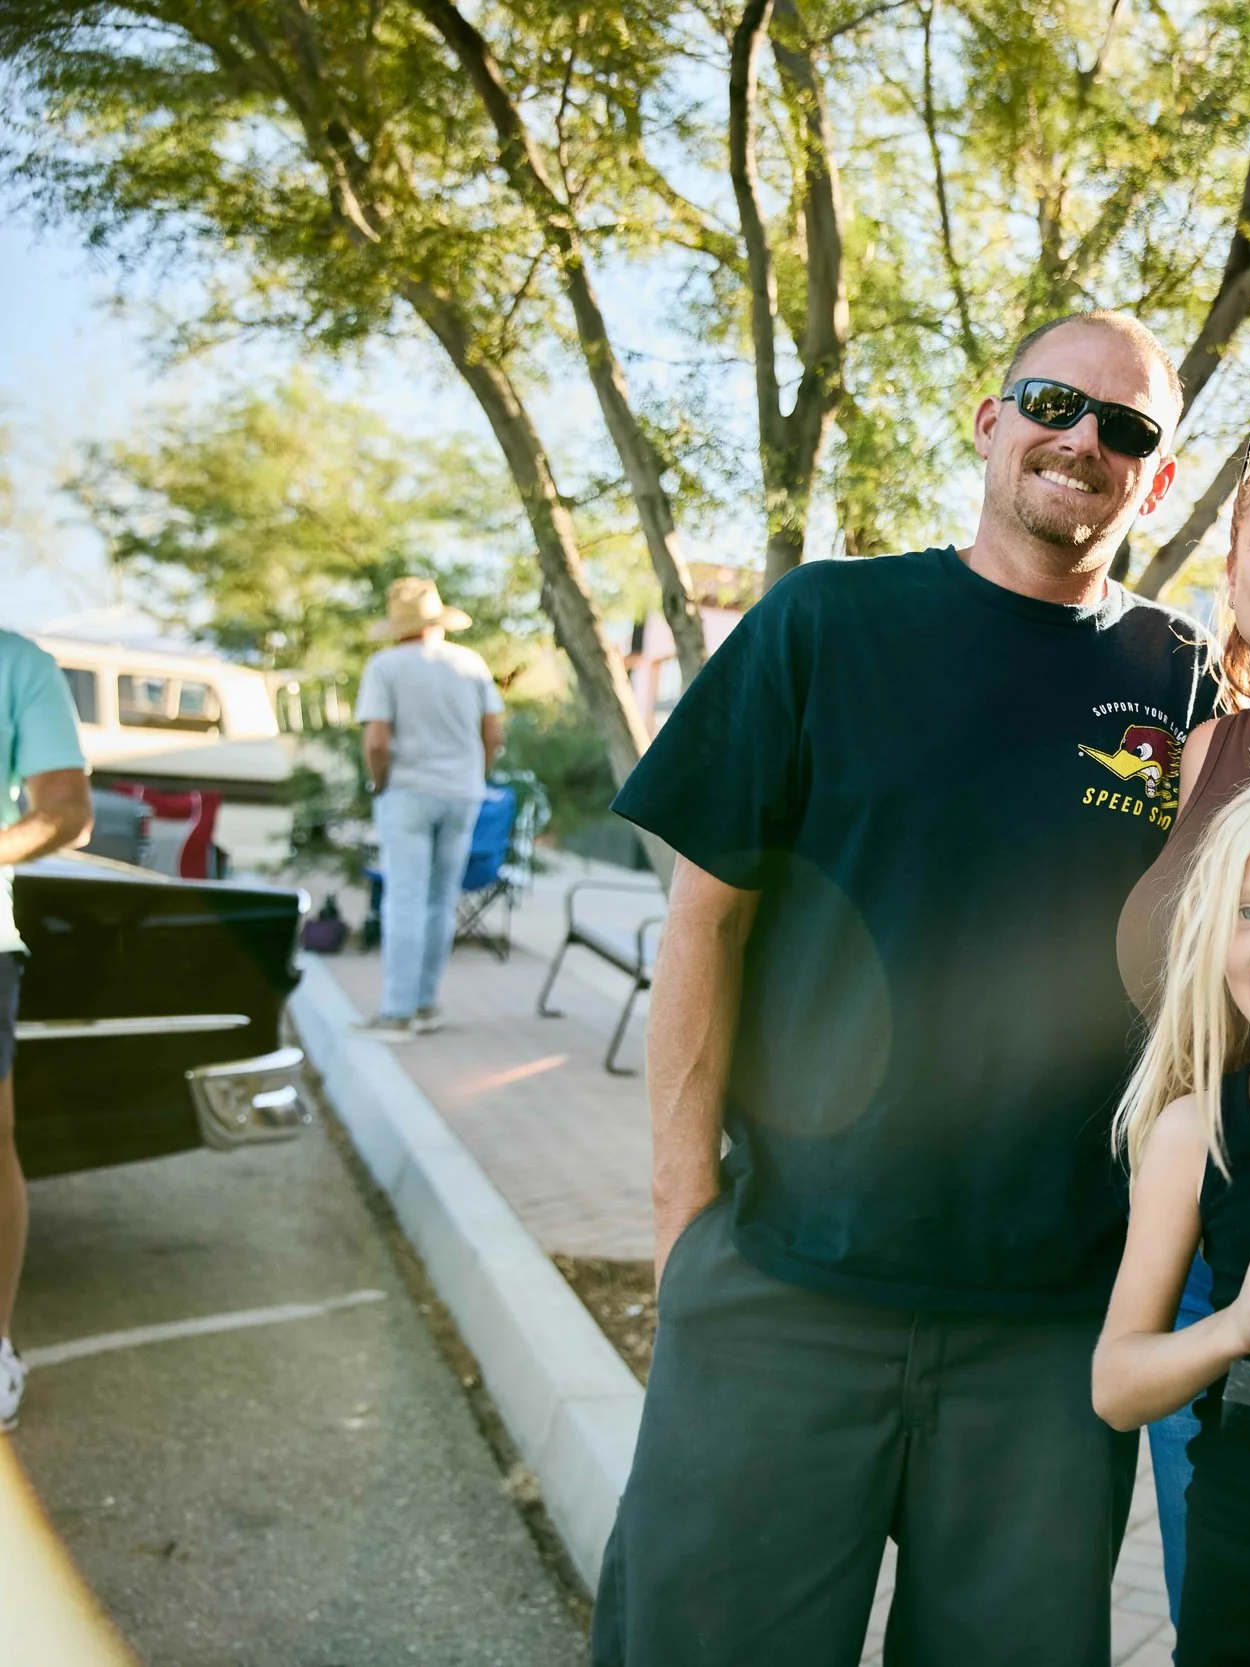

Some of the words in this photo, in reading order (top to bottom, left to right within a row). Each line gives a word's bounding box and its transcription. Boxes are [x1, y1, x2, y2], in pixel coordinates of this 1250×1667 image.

[1092, 702, 1139, 717] SUPPORT
[1144, 706, 1168, 724] YOUR
[1170, 722, 1187, 743] LOCA
[1083, 788, 1143, 815] SPEED
